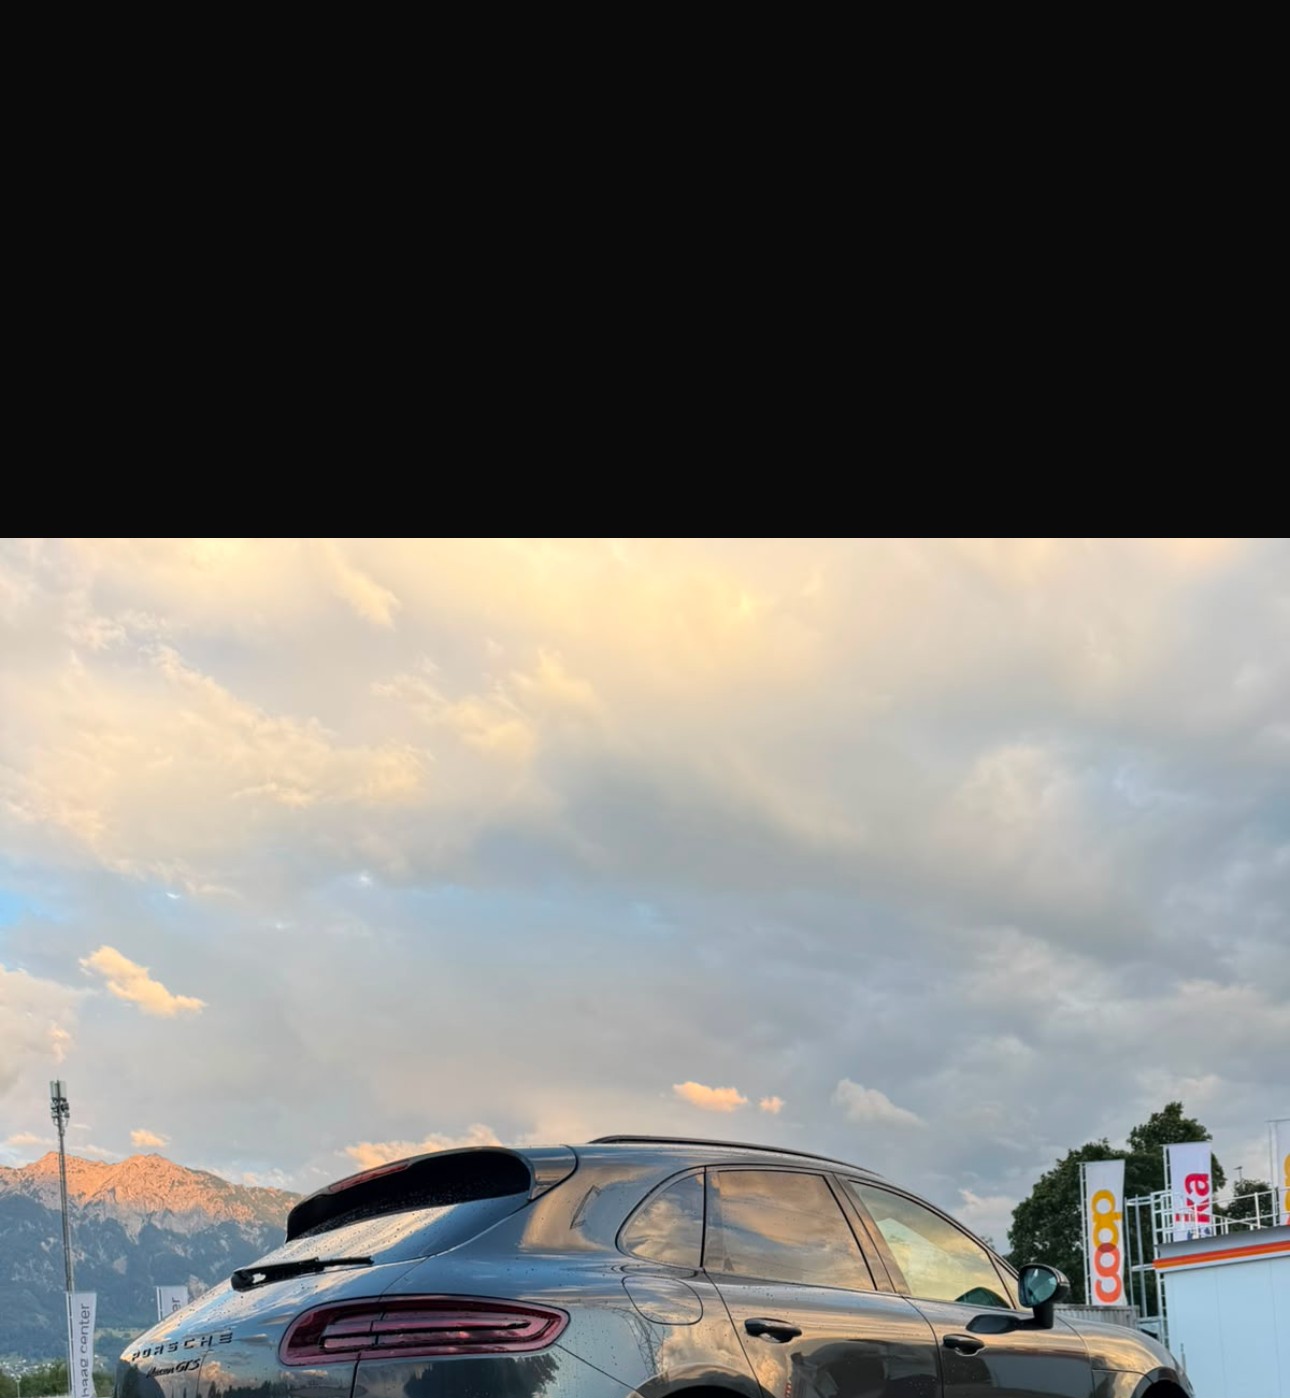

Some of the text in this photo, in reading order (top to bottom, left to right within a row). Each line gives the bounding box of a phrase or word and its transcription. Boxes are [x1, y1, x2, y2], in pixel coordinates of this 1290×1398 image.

[1092, 1190, 1121, 1302] coop
[79, 1303, 90, 1354] center
[132, 1332, 233, 1361] PORSCHE
[176, 1358, 201, 1373] GTS
